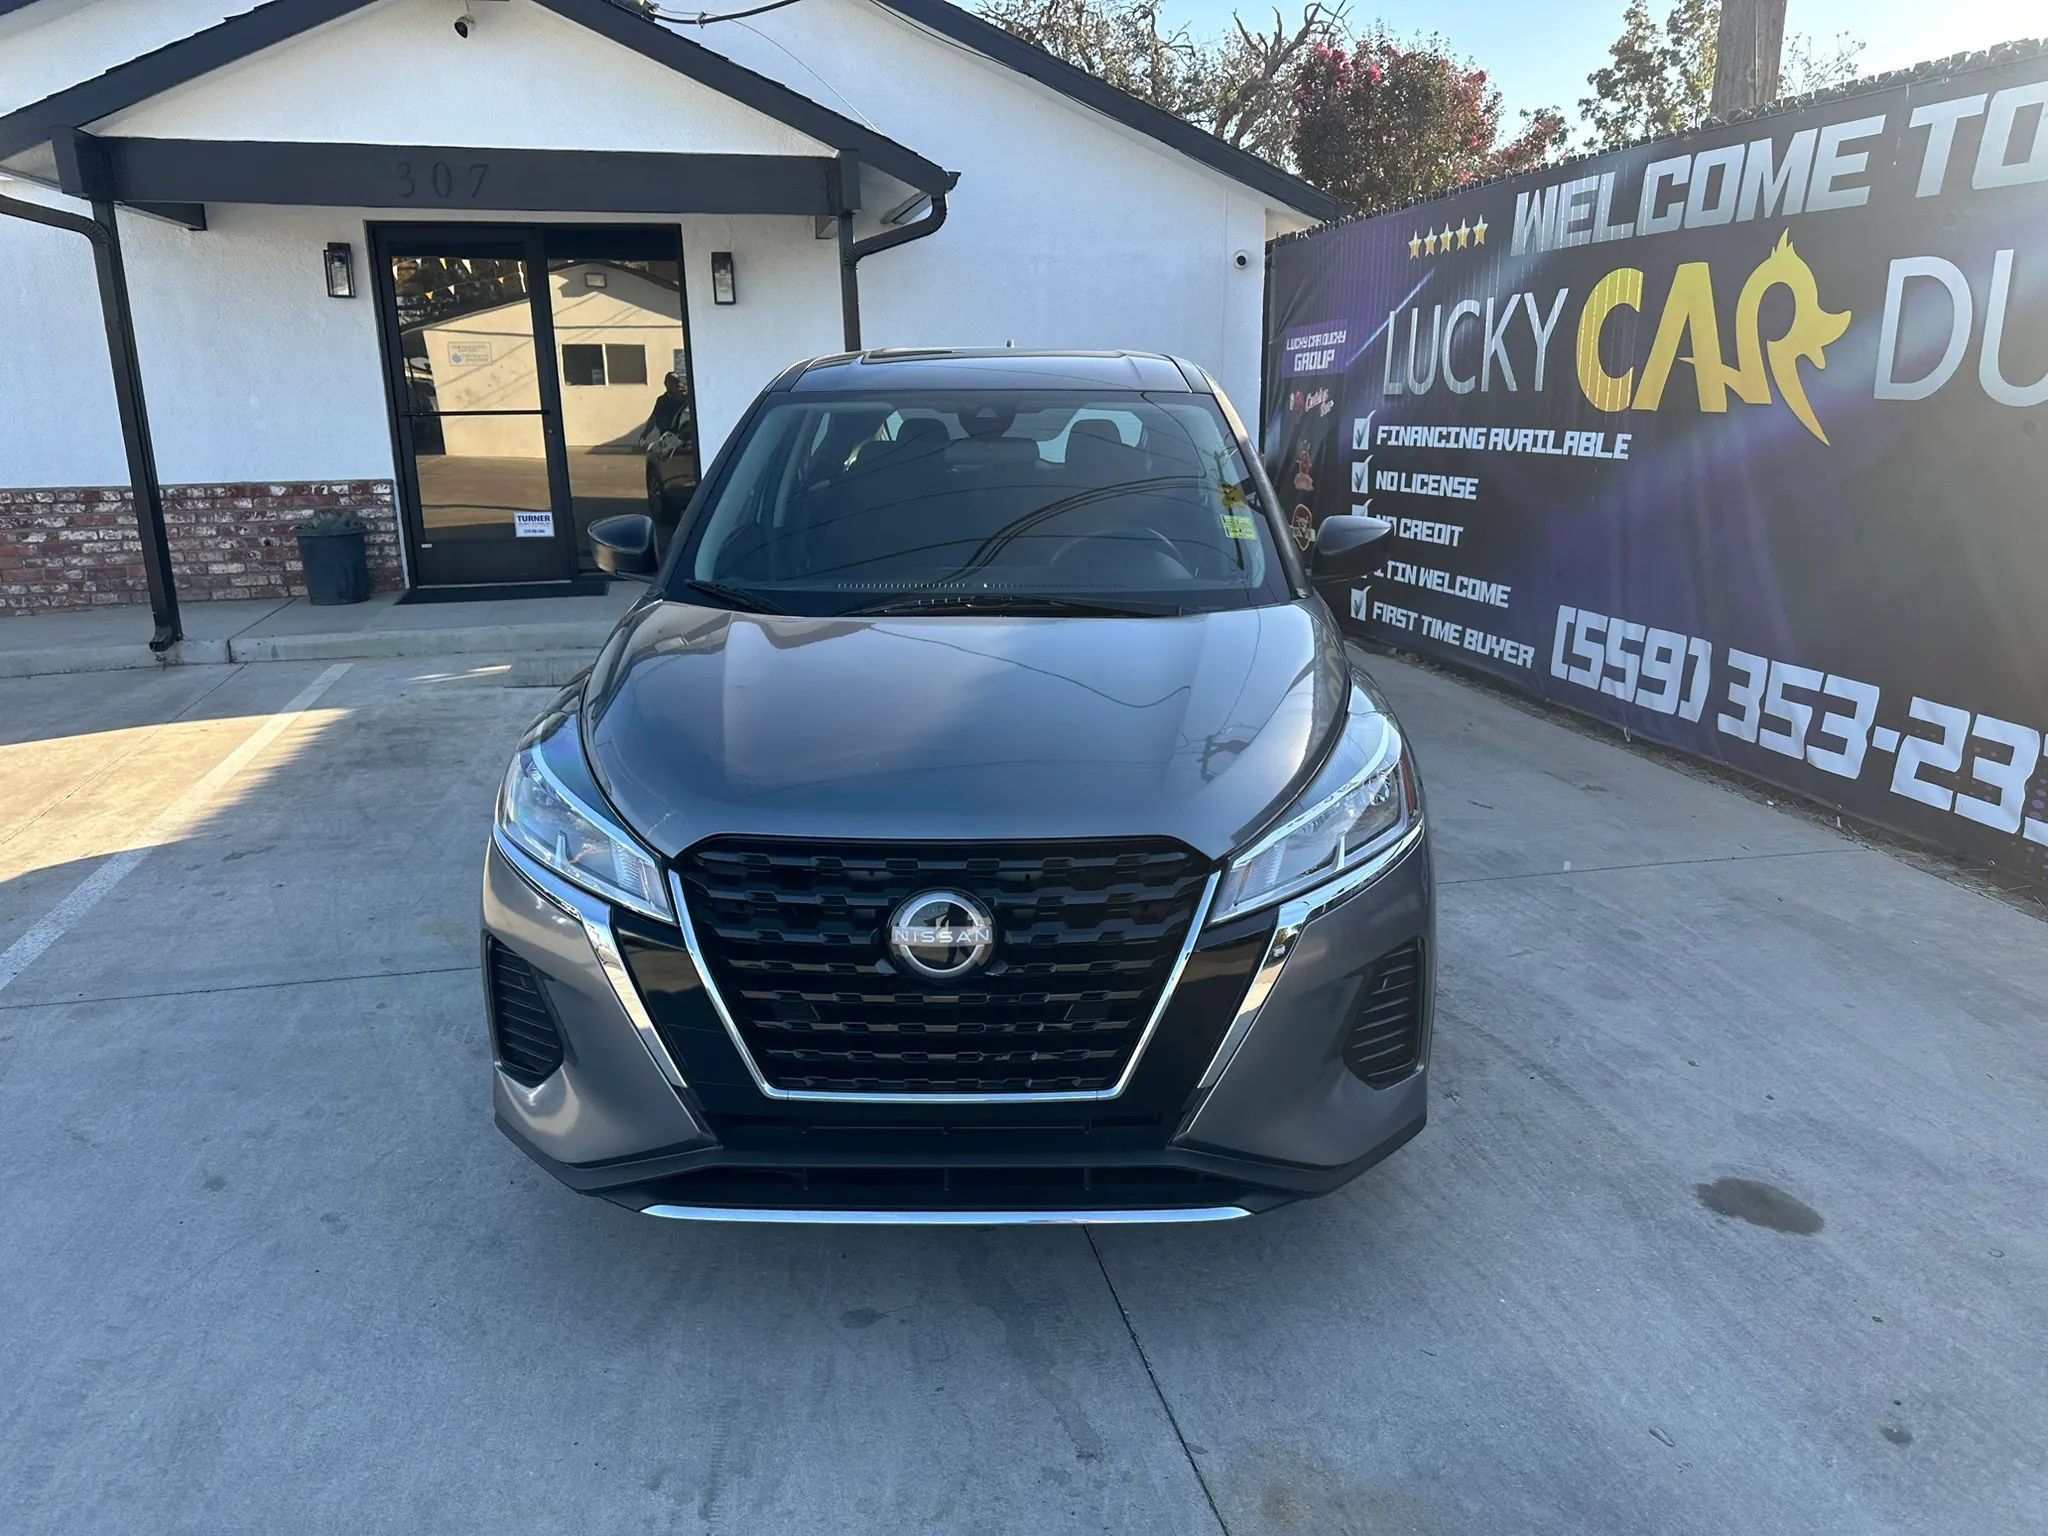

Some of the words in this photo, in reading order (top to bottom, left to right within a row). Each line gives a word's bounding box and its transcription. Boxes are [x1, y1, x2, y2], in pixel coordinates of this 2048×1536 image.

[397, 161, 489, 198] 307
[1510, 113, 1886, 256] WELCOME
[1909, 81, 2048, 198] TO
[1383, 287, 1569, 395] LUCKY
[1576, 227, 1852, 446] CAR
[1294, 348, 1335, 372] GROUP
[1376, 425, 1487, 450] FINANCING
[1488, 427, 1632, 460] AVAILABLE
[1375, 470, 1399, 491] NO
[1400, 472, 1479, 500] LICENSE
[517, 514, 551, 523] TURNER
[1399, 517, 1464, 547] CREDIT
[1418, 566, 1511, 609] WELCOME
[1372, 601, 1418, 631] FIRST
[1421, 614, 1462, 646] TIME
[1463, 628, 1535, 669] BUYER
[1551, 604, 1712, 724] (559)
[1717, 647, 2048, 848] 353-23
[895, 929, 990, 943] NISSAN
